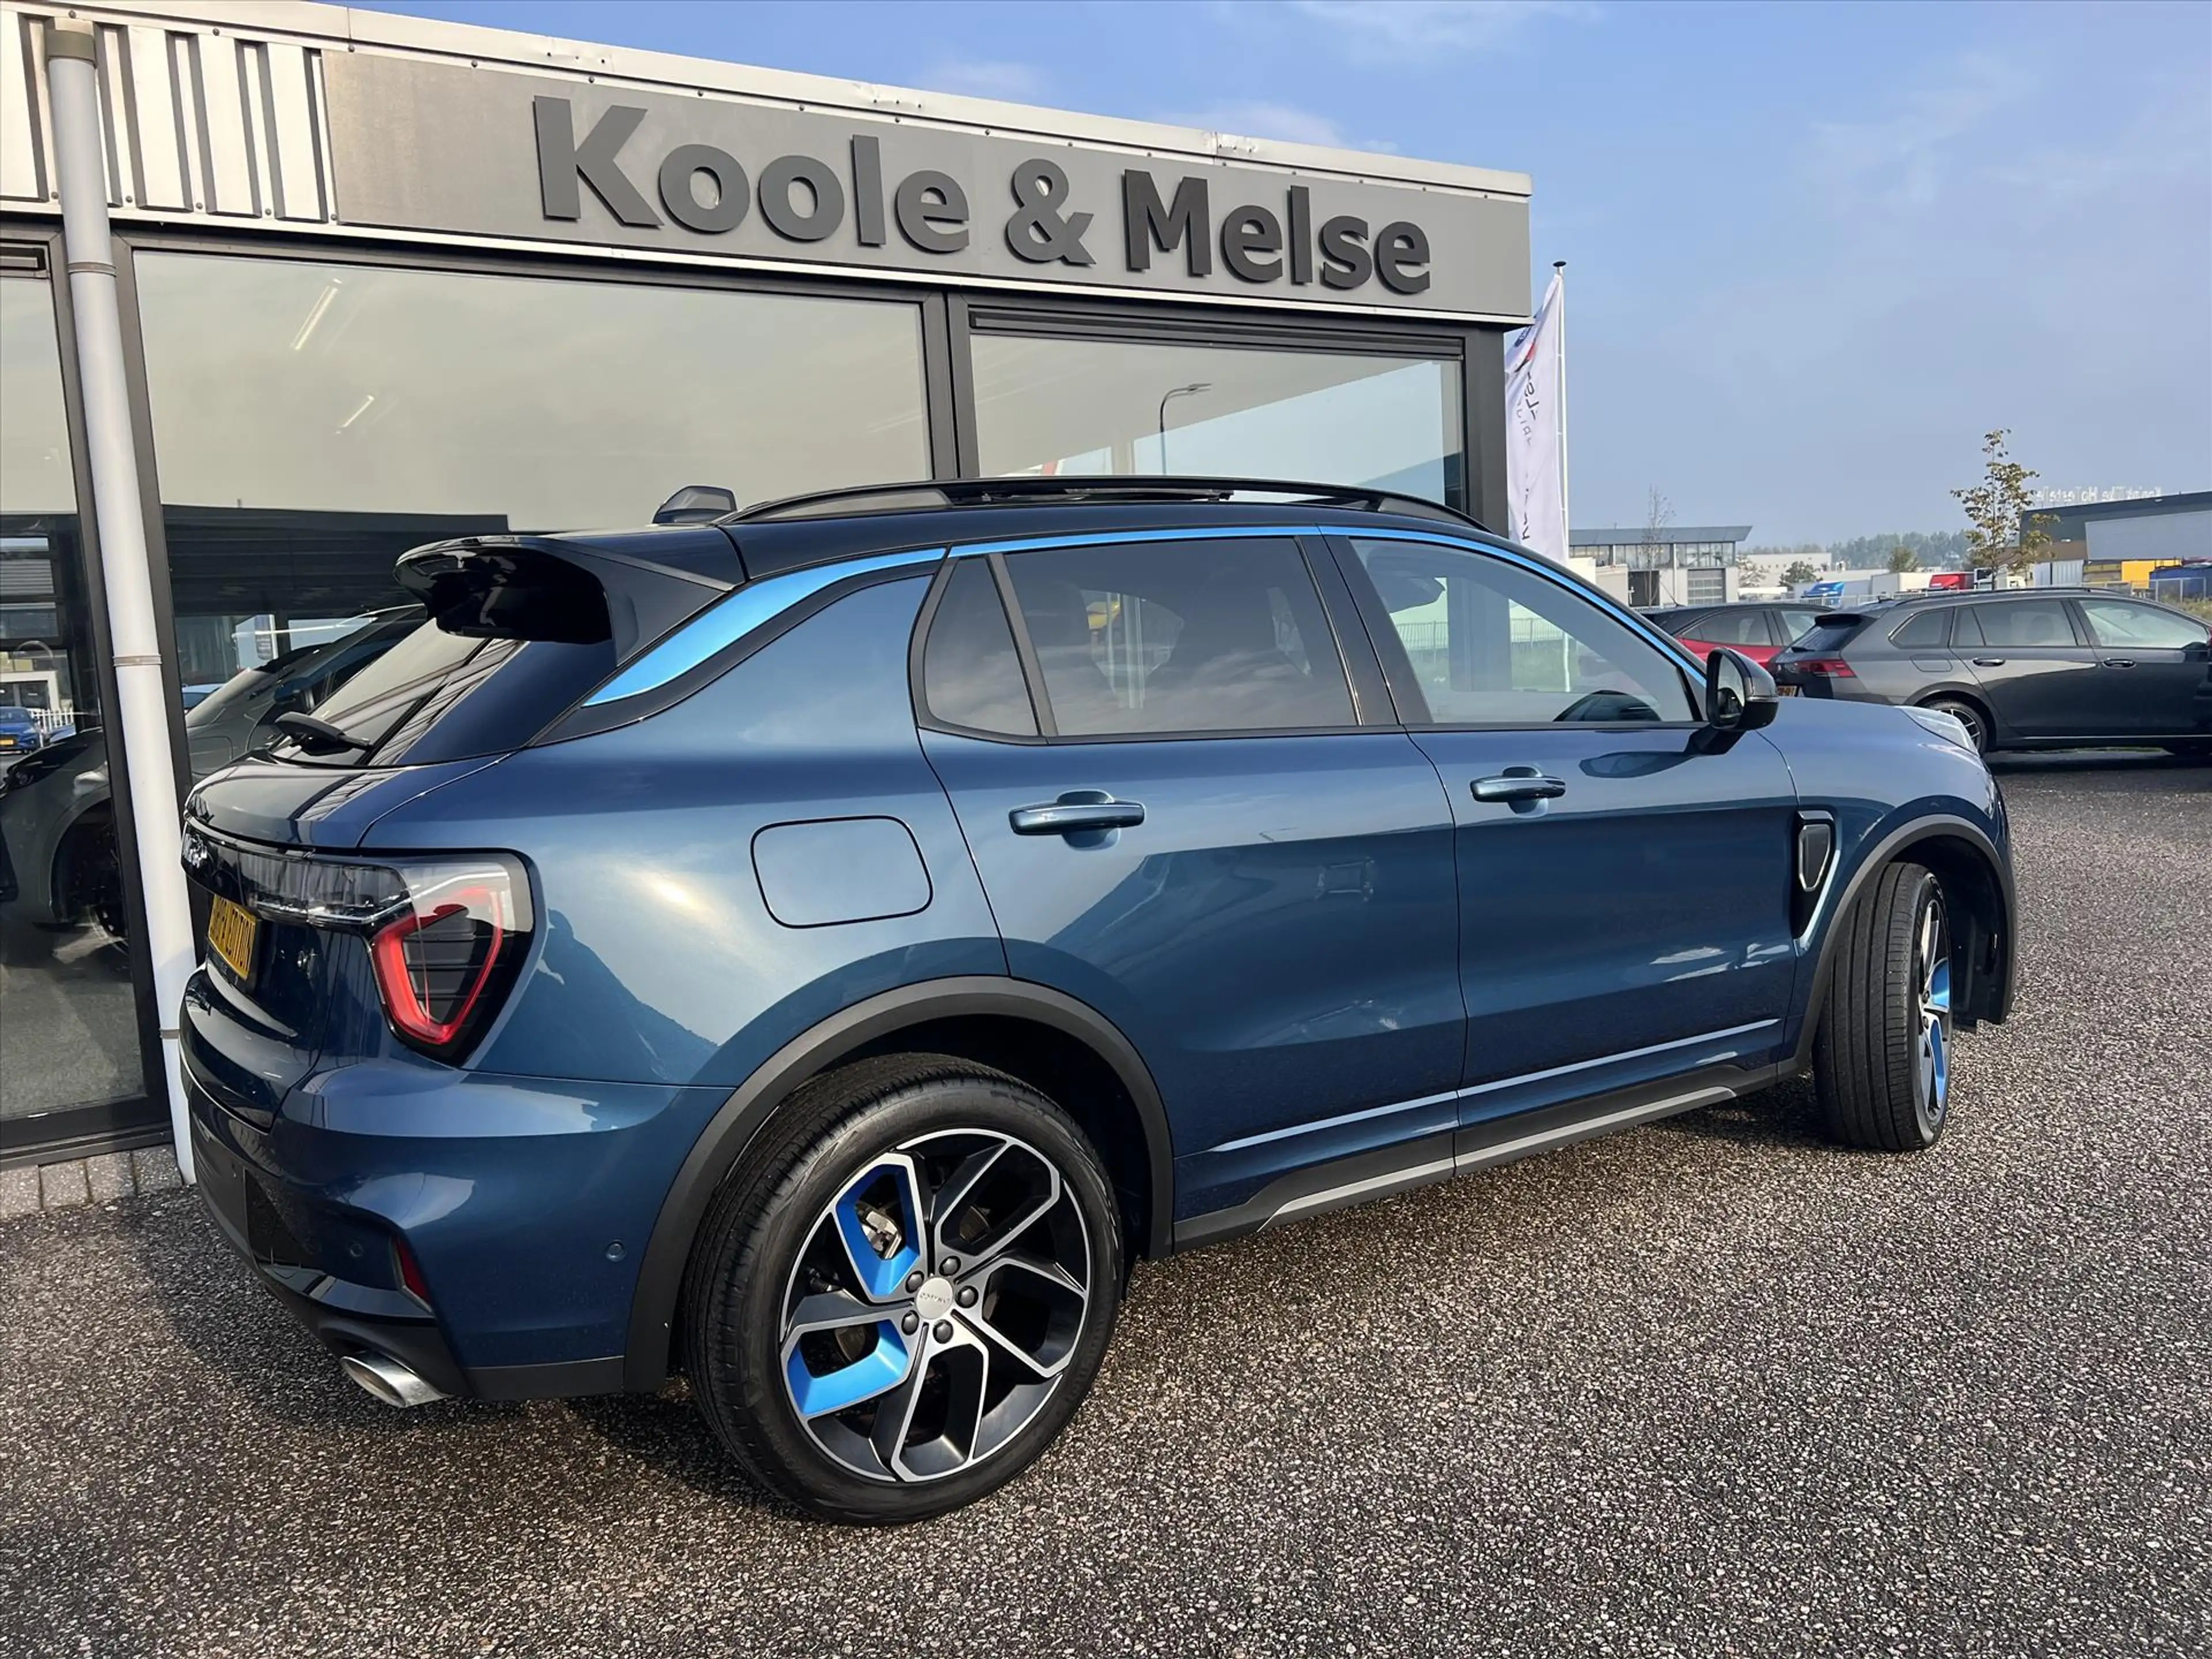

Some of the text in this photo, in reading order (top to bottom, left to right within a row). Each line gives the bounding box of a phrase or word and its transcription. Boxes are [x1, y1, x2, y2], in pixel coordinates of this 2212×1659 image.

[533, 95, 1431, 294] Koole & Melse
